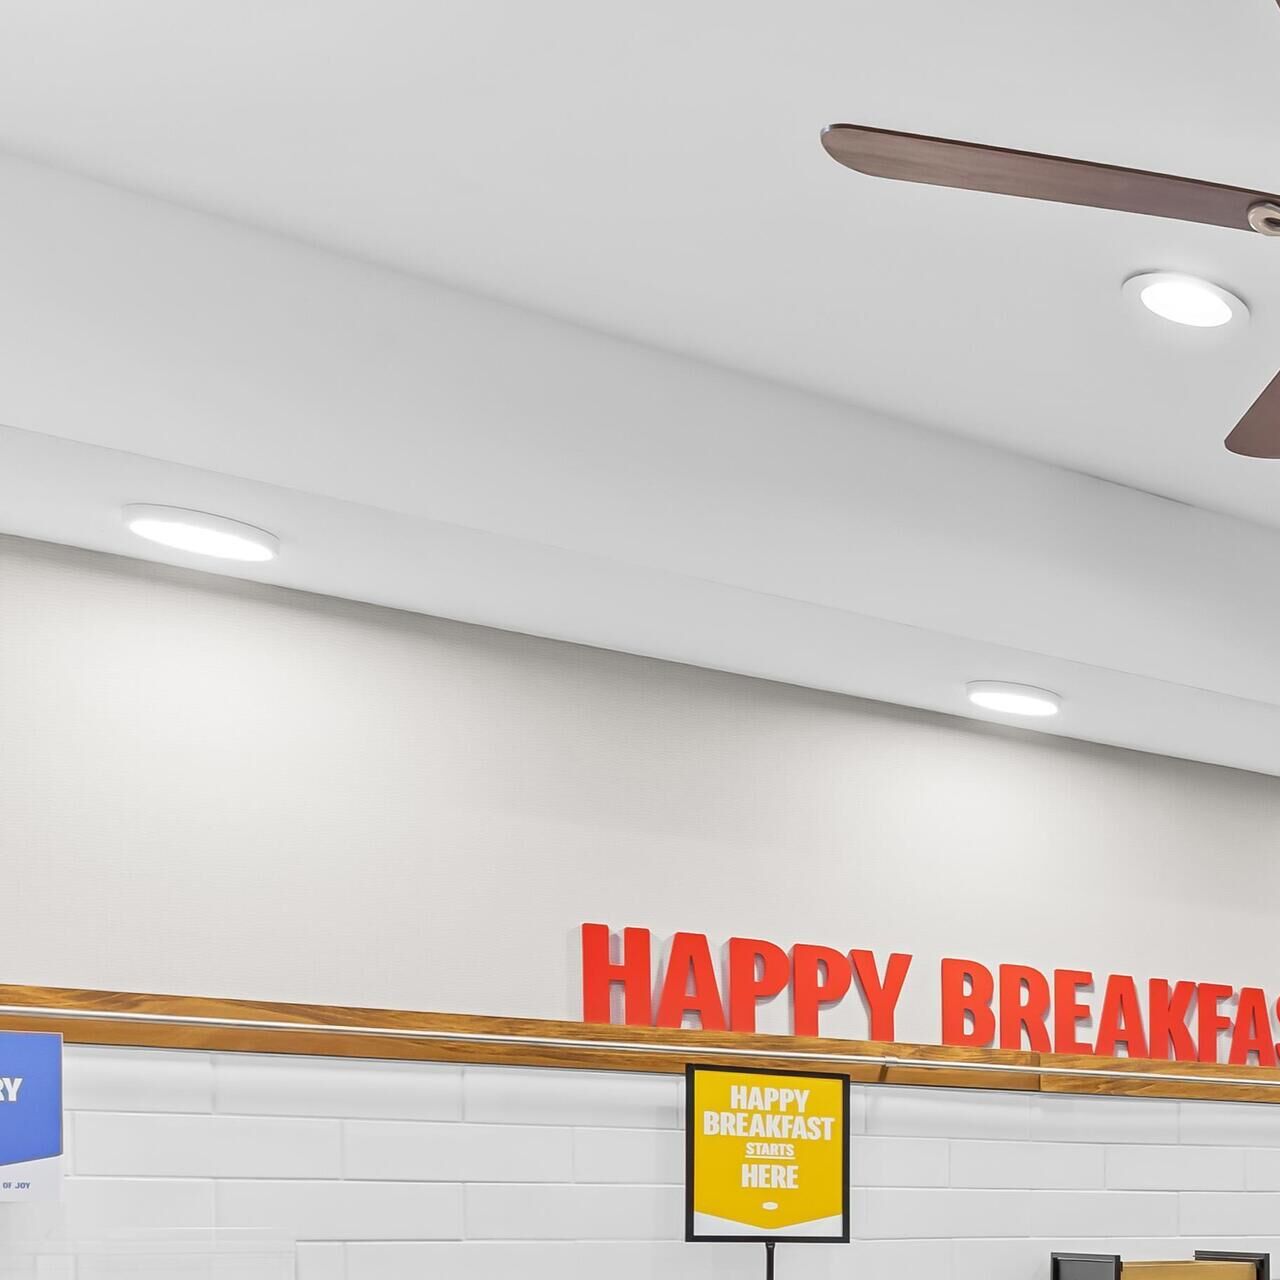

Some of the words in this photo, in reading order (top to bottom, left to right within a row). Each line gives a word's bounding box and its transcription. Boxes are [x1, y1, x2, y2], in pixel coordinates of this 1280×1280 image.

[582, 923, 912, 1042] HAPPY
[730, 1085, 810, 1113] HAPPY
[703, 1111, 836, 1140] BREAKFAST
[745, 1142, 796, 1157] STARTS
[741, 1163, 800, 1189] HERE
